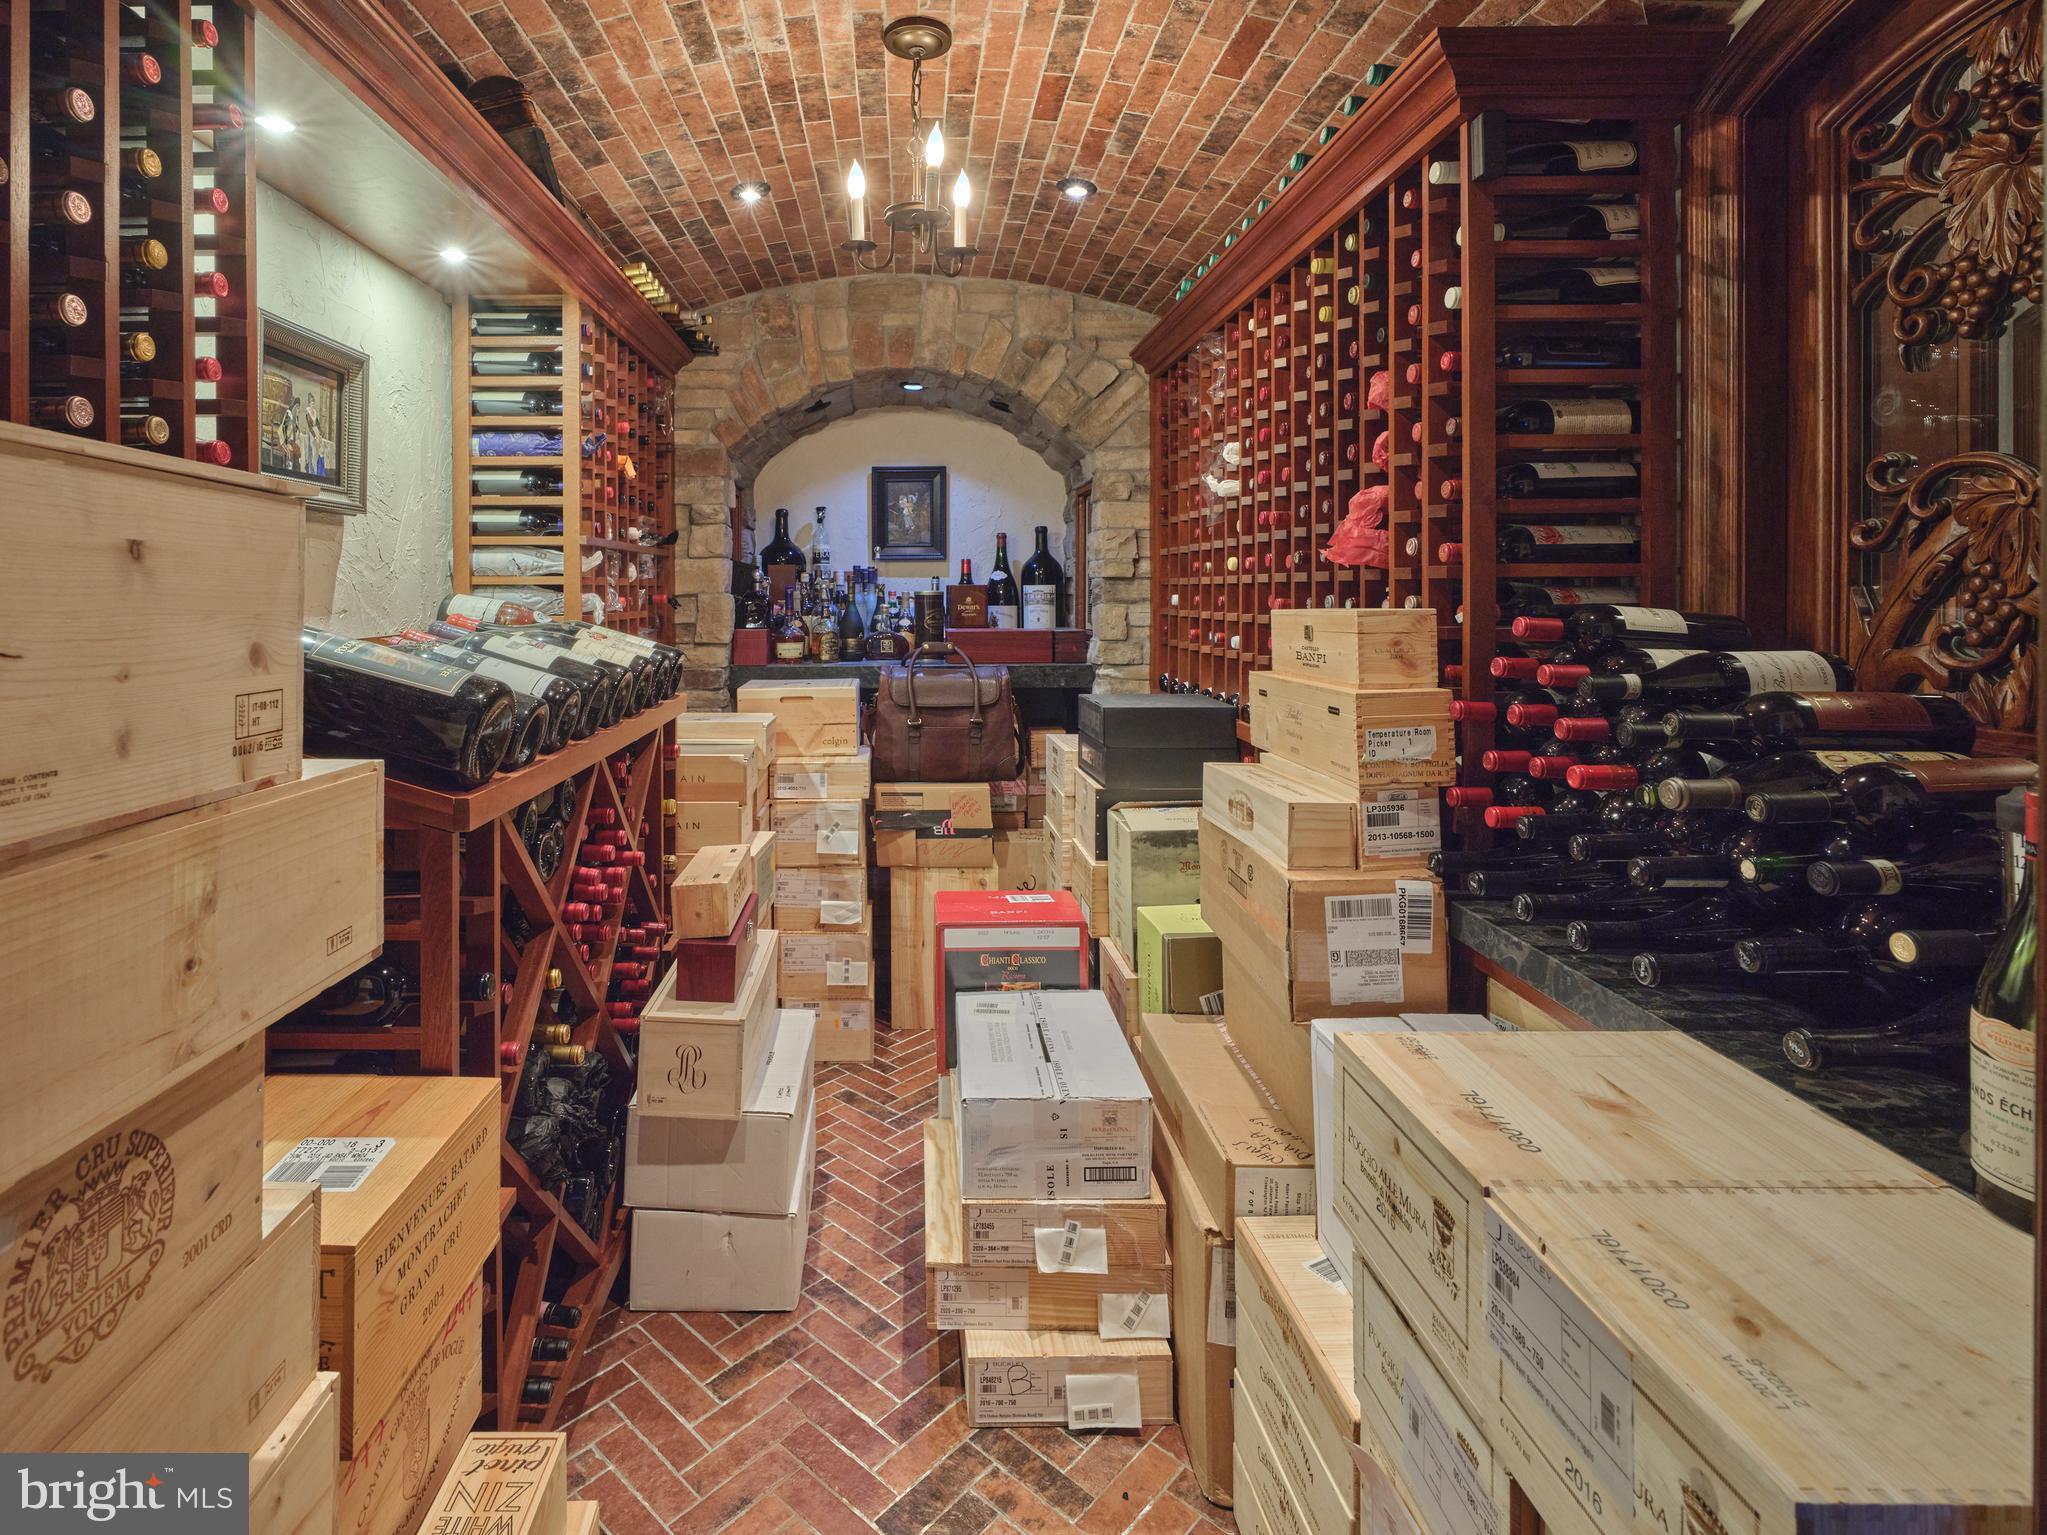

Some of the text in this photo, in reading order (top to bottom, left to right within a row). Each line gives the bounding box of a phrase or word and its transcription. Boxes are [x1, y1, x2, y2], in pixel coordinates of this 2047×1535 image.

[1296, 650, 1327, 664] BANFI
[252, 716, 261, 727] HT
[1368, 728, 1432, 739] Temperature Room
[822, 736, 849, 748] colgin
[1368, 740, 1391, 748] Picker
[1368, 750, 1376, 758] ID
[1366, 804, 1405, 813] LP305936
[1367, 830, 1435, 841] 2013-10568-1500
[980, 953, 1047, 966] CHIANTI CLASSICO
[75, 1132, 123, 1181] CRU
[1348, 1126, 1378, 1173] POGGIO
[1378, 1168, 1399, 1199] ALLE
[1399, 1187, 1429, 1237] MURA
[375, 1127, 488, 1276] BIENVENUES BATARD
[1376, 1195, 1396, 1231] 2016
[182, 1212, 235, 1270] 2001 CRD
[396, 1181, 469, 1286] MONTRACHET
[3, 1187, 69, 1362] PREMIER
[400, 1220, 463, 1316] GRAND CRU
[1507, 1231, 1552, 1285] BUCKLEY
[61, 1268, 132, 1342] YQUEM
[443, 1480, 535, 1514] ZIN
[1563, 1456, 1669, 1533] 2016 URA
[430, 1515, 514, 1535] WHITE
